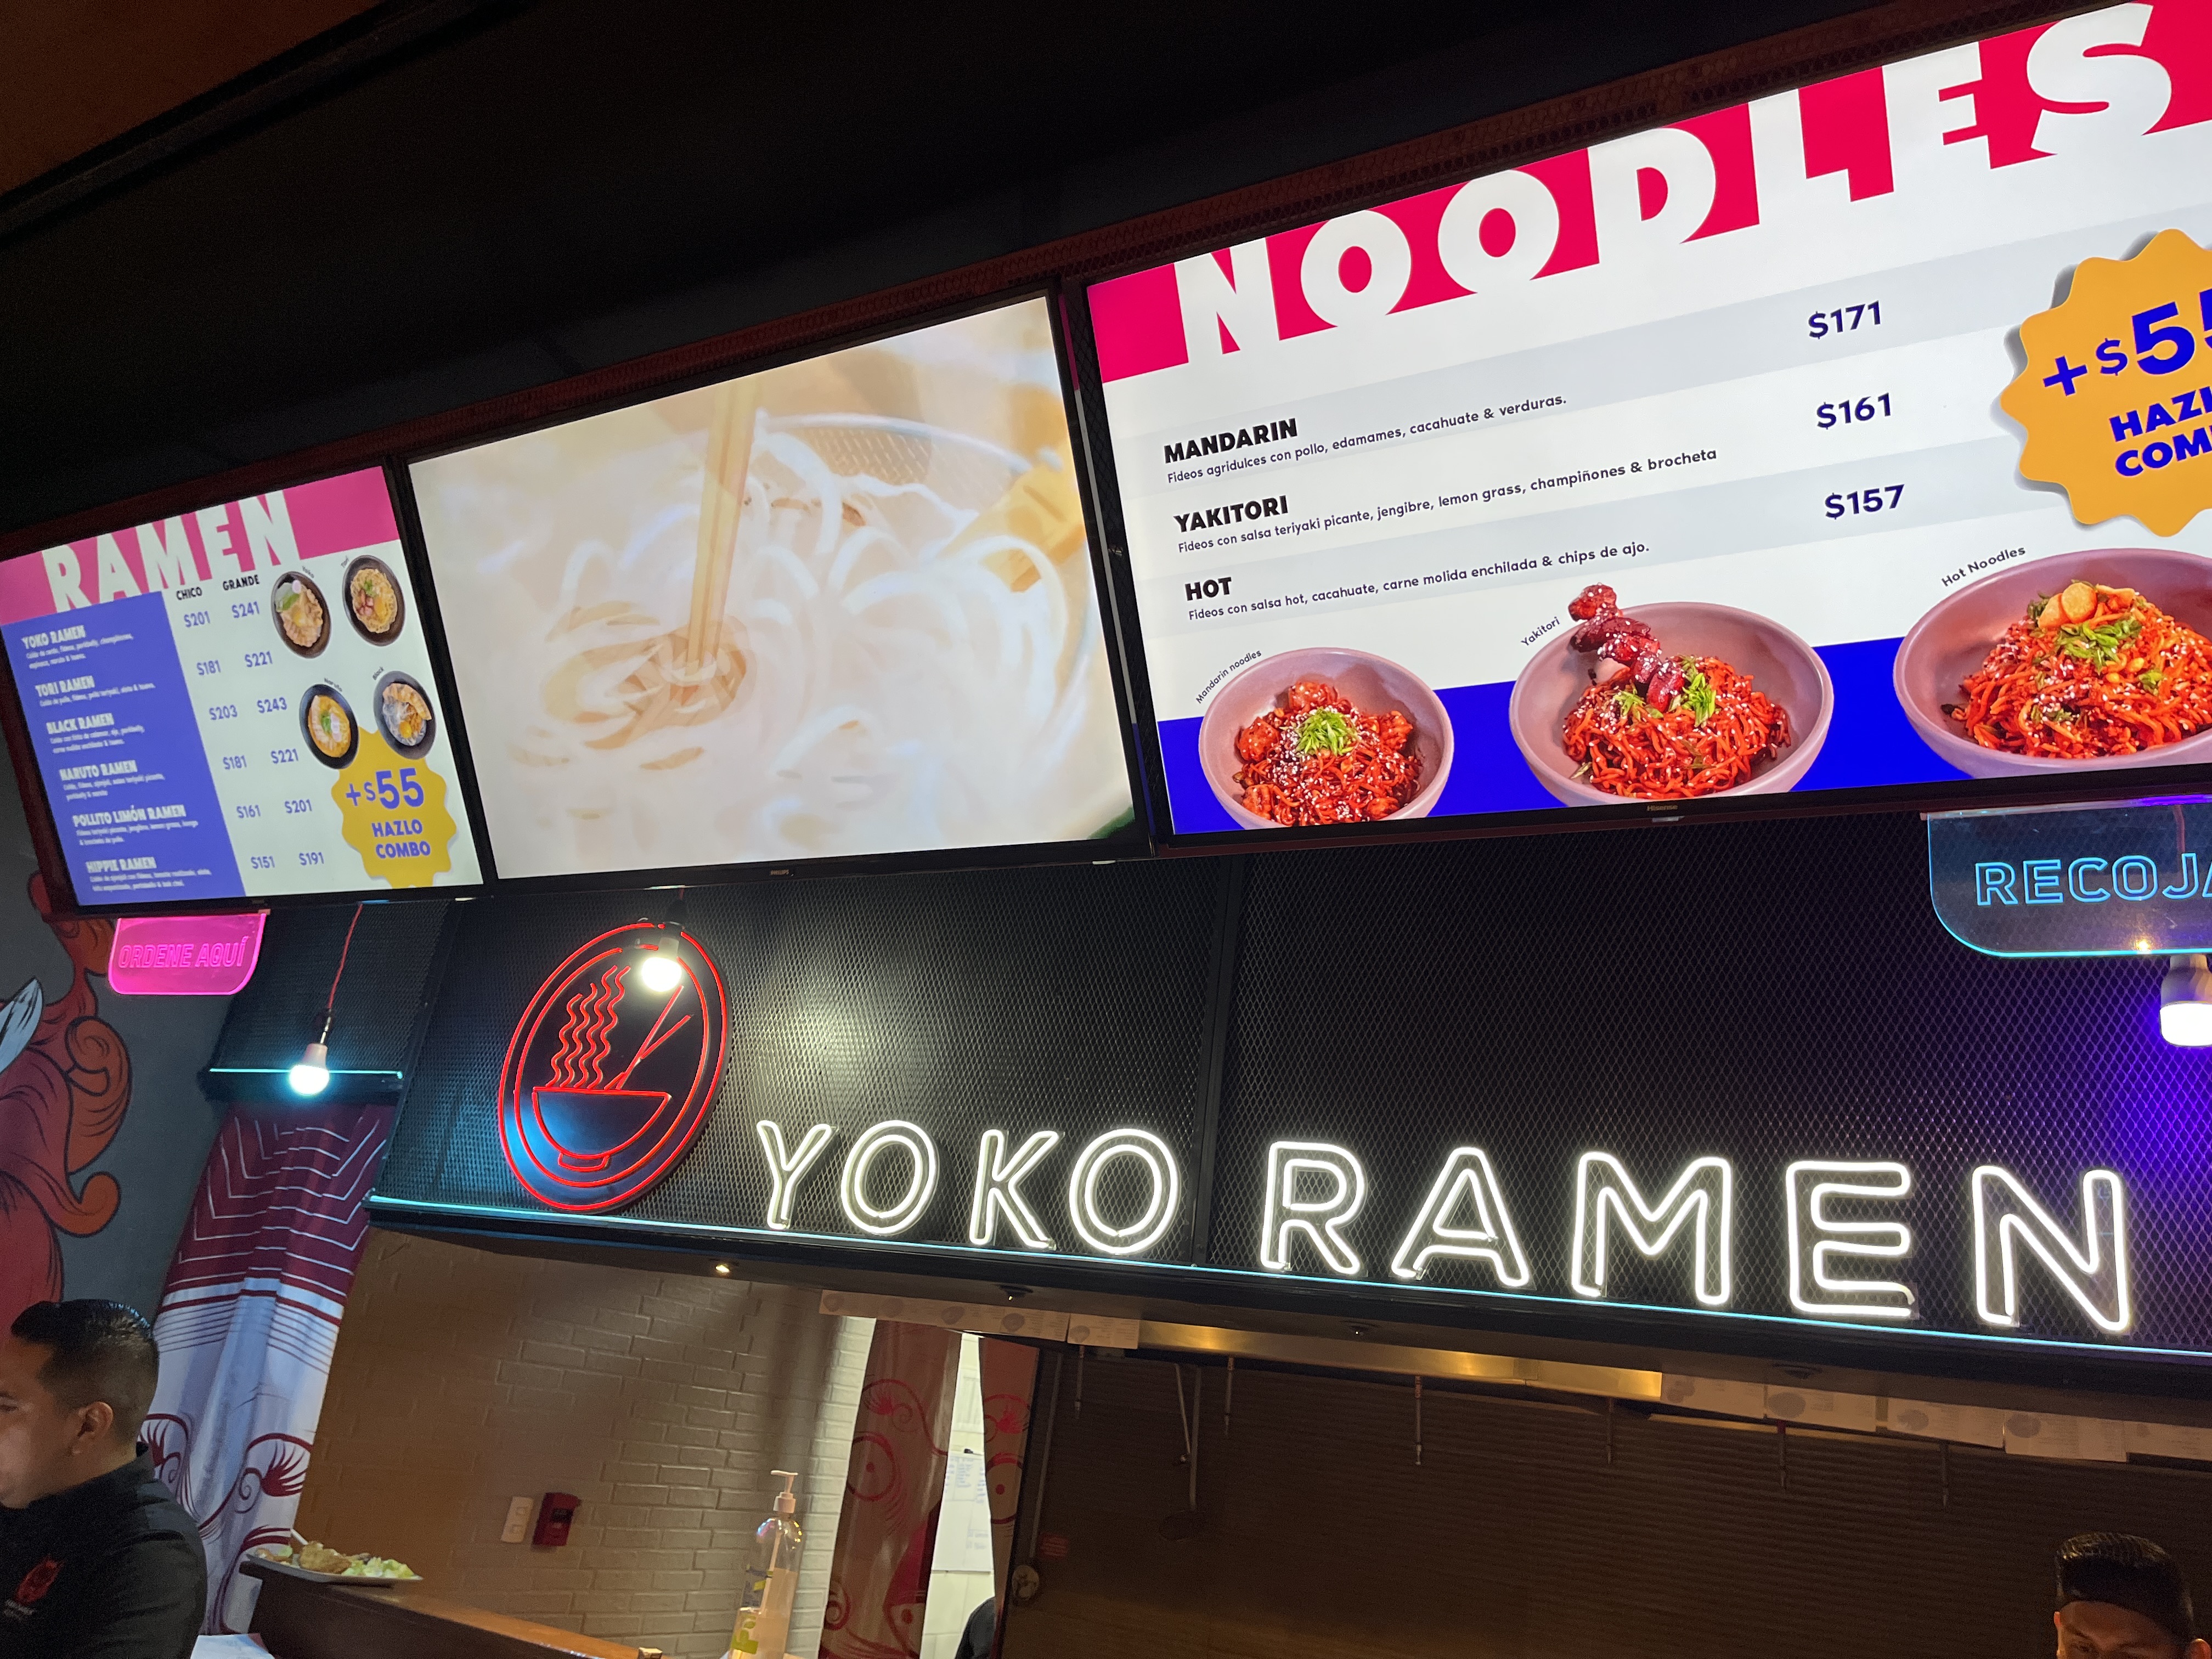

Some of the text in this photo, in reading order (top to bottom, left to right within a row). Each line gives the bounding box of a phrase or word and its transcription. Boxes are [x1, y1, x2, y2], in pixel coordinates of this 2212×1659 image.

[1173, 2, 2171, 362] NOODLES
[1808, 300, 1881, 340] $171
[2042, 288, 2212, 397] +$5
[1816, 392, 1891, 430] $161
[1164, 417, 1298, 464] MANDARIN
[1167, 395, 1567, 484] Fideos agridulces con pollo, edamames, cacahuate & verduras.
[1173, 495, 1289, 533] YAKITORI
[1178, 448, 1717, 554] Fideos con salsa teriyaki picante, jengibre, lemon grass, champiñones & brocheta
[1825, 483, 1905, 520] $157
[42, 490, 300, 613] RAMEN
[1941, 547, 2026, 587] Hot Noodles
[176, 574, 260, 601] CHICO GRANDE
[1184, 577, 1232, 601] HOT
[1188, 541, 1650, 620] Fideos con salsa hot, cacahuate, carne molida enchilada & chips de ajo.
[21, 633, 50, 650] YOKO
[1521, 616, 1560, 646] Yakitori
[1195, 650, 1262, 704] Mandarin noodles
[371, 819, 422, 837] HAZLO
[376, 840, 431, 859] COMBO
[1975, 852, 2212, 906] RECOJ
[118, 936, 249, 968] ORDENE AQUÍ
[757, 1119, 2131, 1333] YOKO RAMEN
